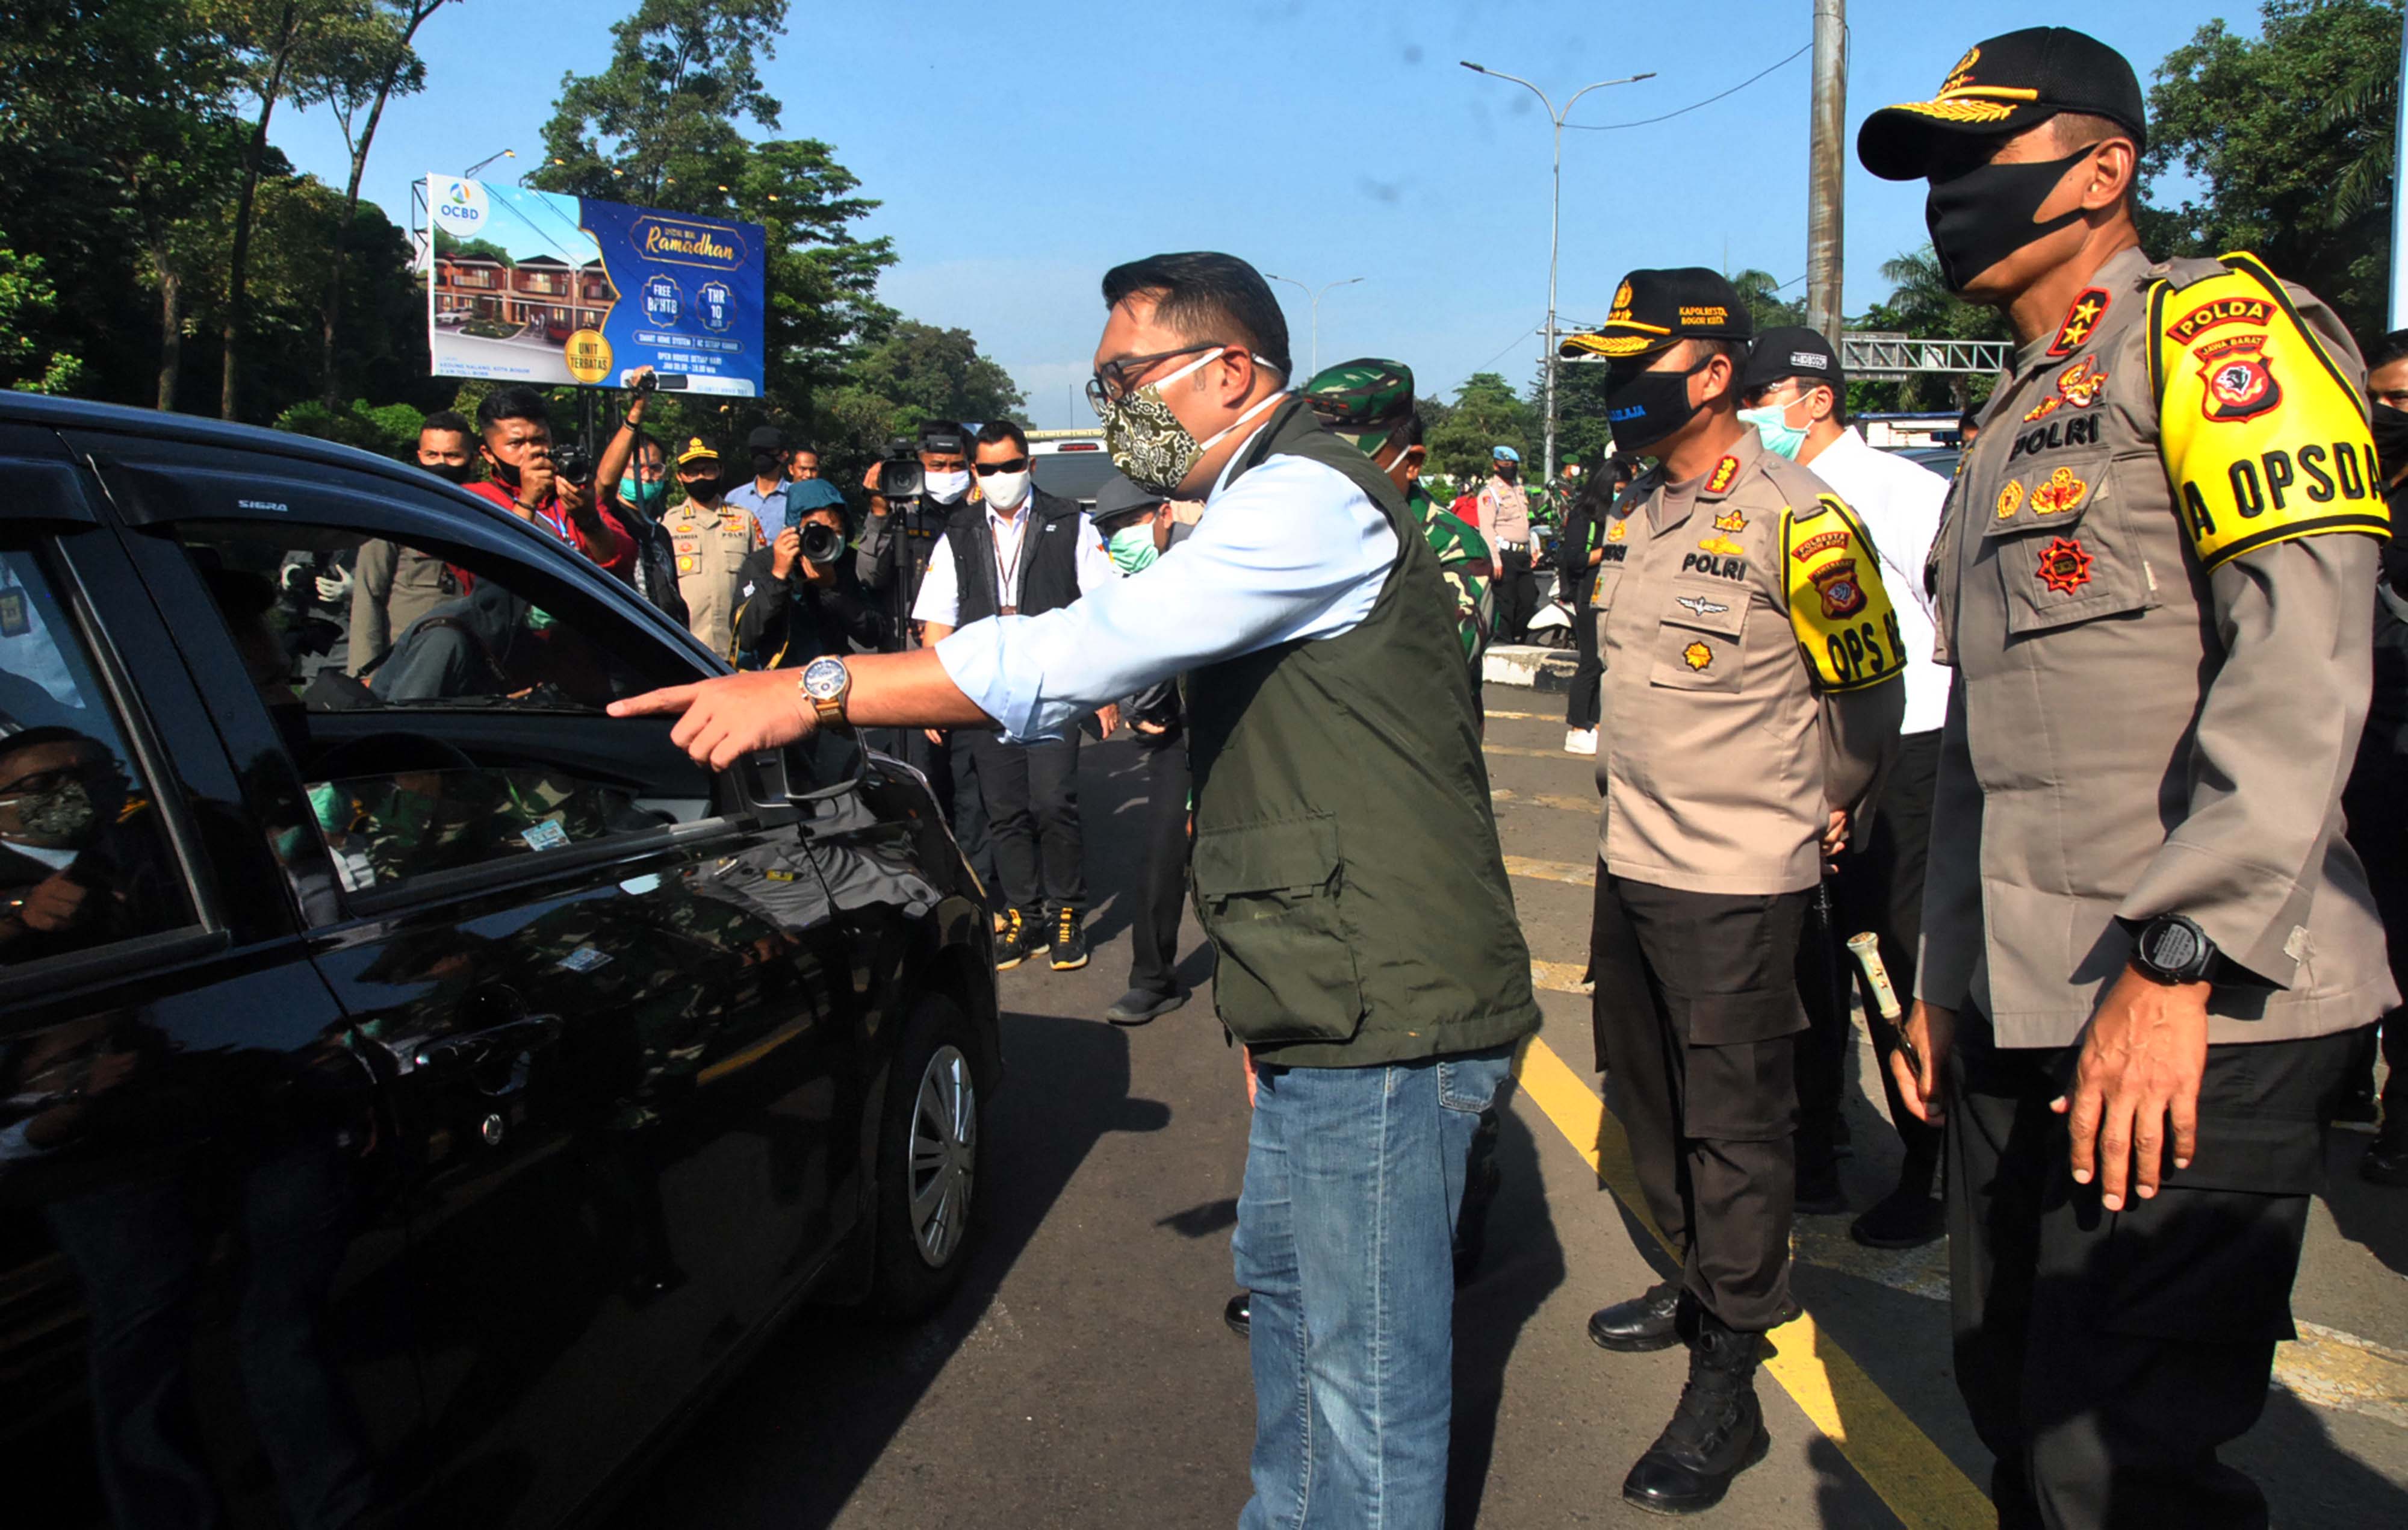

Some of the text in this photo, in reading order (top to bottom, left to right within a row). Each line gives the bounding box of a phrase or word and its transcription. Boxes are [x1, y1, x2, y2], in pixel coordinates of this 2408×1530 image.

[441, 205, 479, 219] OCBD
[646, 226, 734, 260] Ramadhan
[654, 284, 671, 297] FREE
[707, 288, 725, 303] THR
[648, 296, 677, 314] BPHTB
[711, 305, 722, 319] 10
[1679, 306, 1728, 317] KAPOLRESTA
[1681, 317, 1706, 325] BOGOR
[2180, 301, 2264, 336] POLDA
[579, 342, 598, 354] UNIT
[2203, 337, 2263, 355] JAWA BARAT
[570, 356, 607, 371] TERBATAS
[2009, 412, 2099, 462] POLRI
[238, 499, 288, 512] SIGRA
[1683, 553, 1746, 581] POLRI
[1827, 622, 1884, 682] OPS
